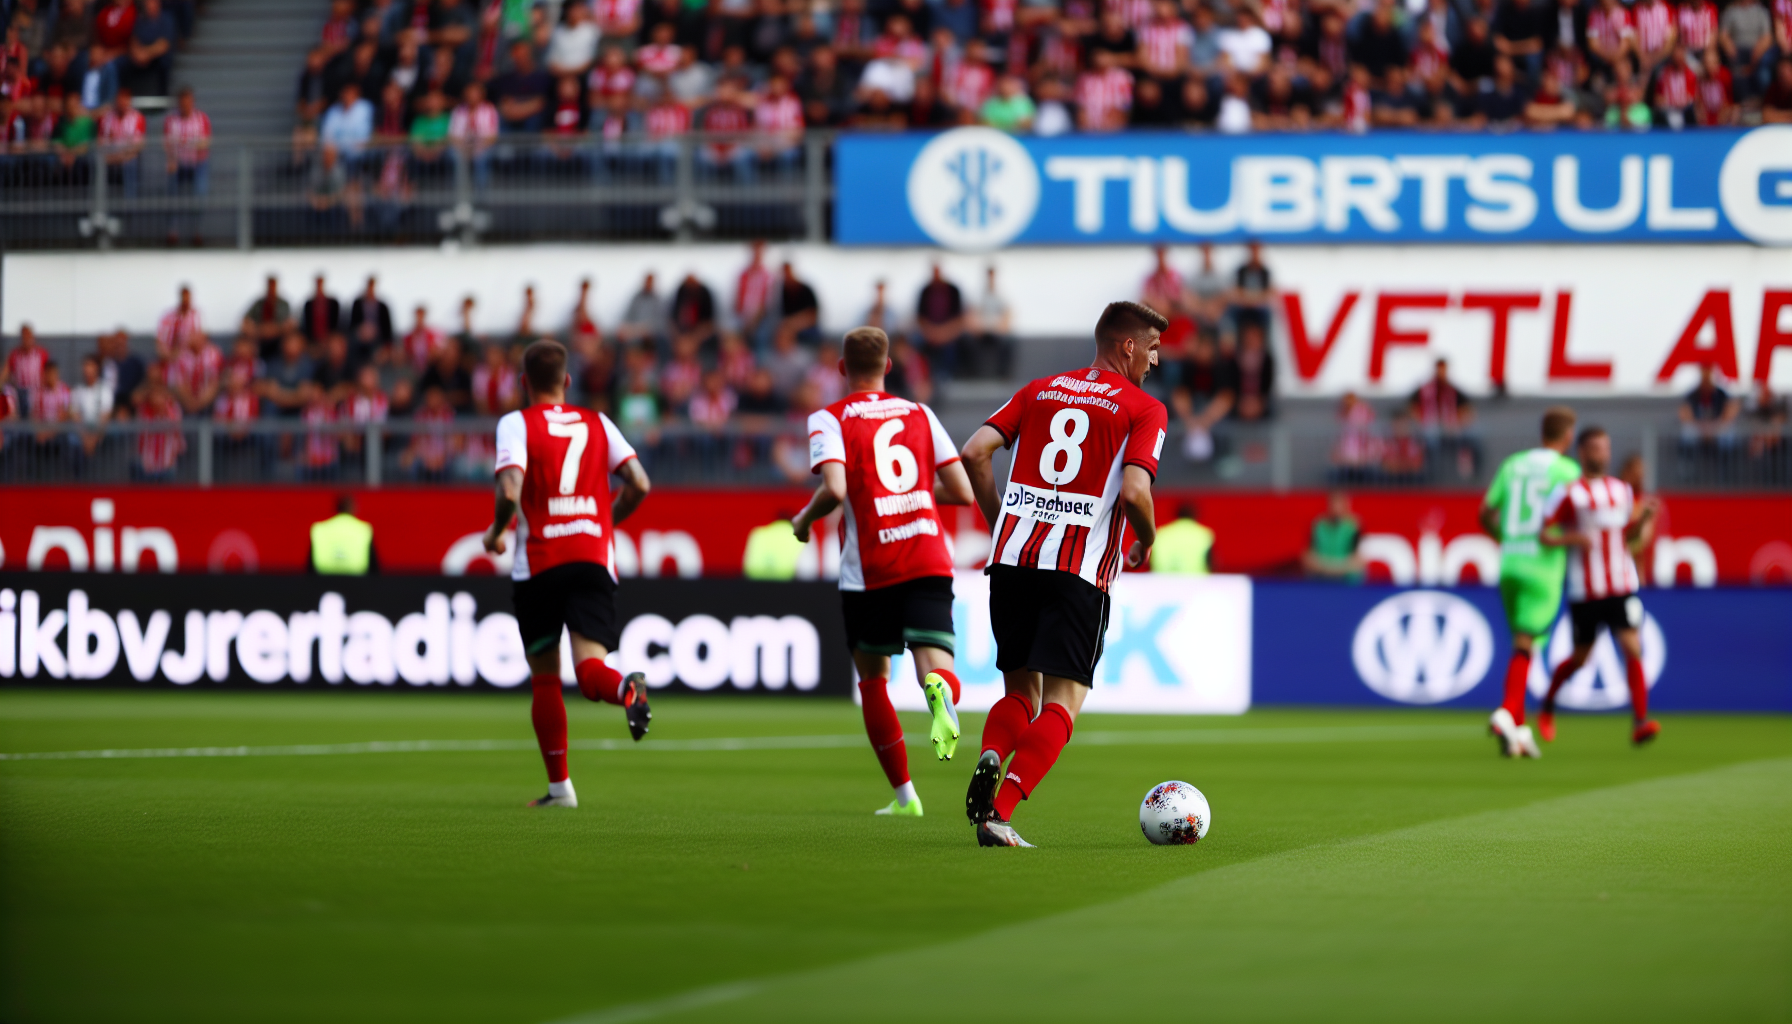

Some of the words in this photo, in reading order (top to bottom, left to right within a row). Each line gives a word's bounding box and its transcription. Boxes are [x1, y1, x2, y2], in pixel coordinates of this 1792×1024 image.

[1281, 289, 1613, 385] VFTL
[547, 421, 589, 495] 7
[873, 418, 919, 494] 6
[1039, 407, 1090, 486] 8
